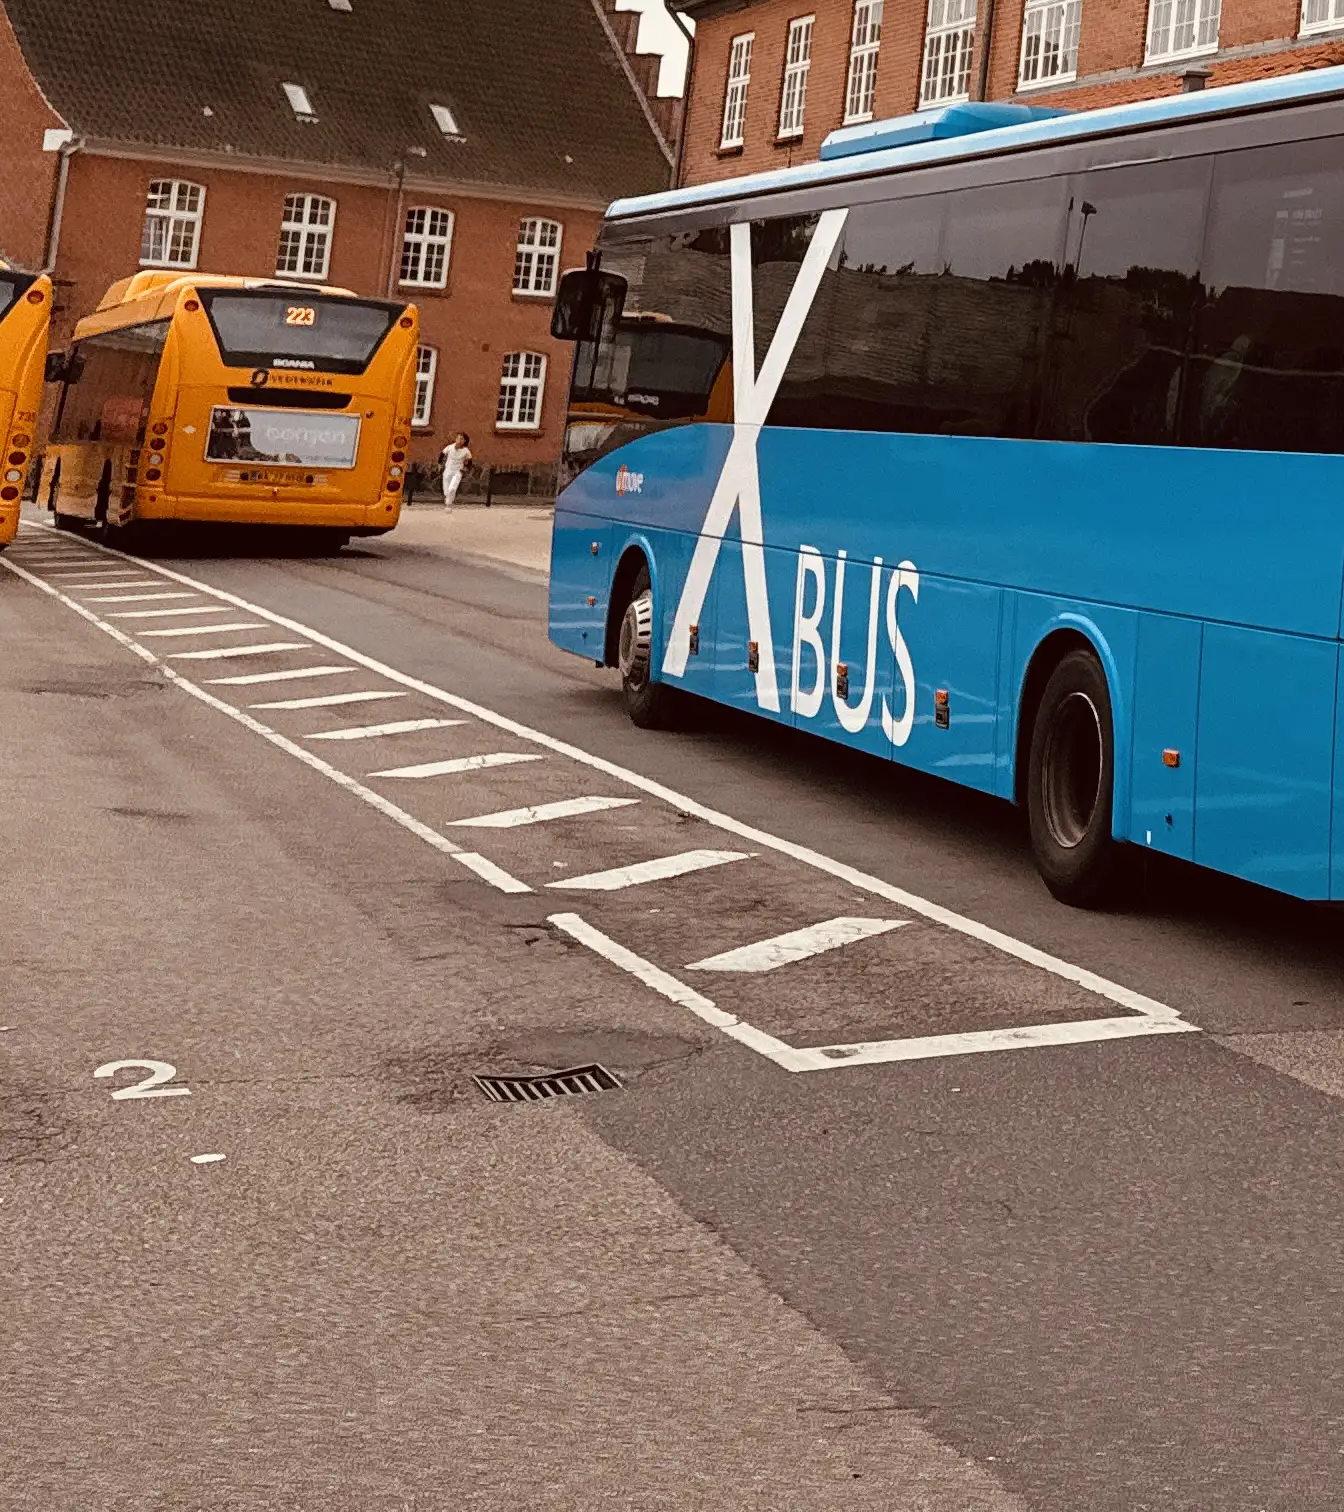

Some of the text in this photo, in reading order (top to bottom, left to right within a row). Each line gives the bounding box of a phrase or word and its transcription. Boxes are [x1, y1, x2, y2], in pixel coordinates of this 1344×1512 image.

[285, 306, 315, 326] 223
[662, 207, 919, 747] X BUS
[93, 1059, 193, 1100] 2
